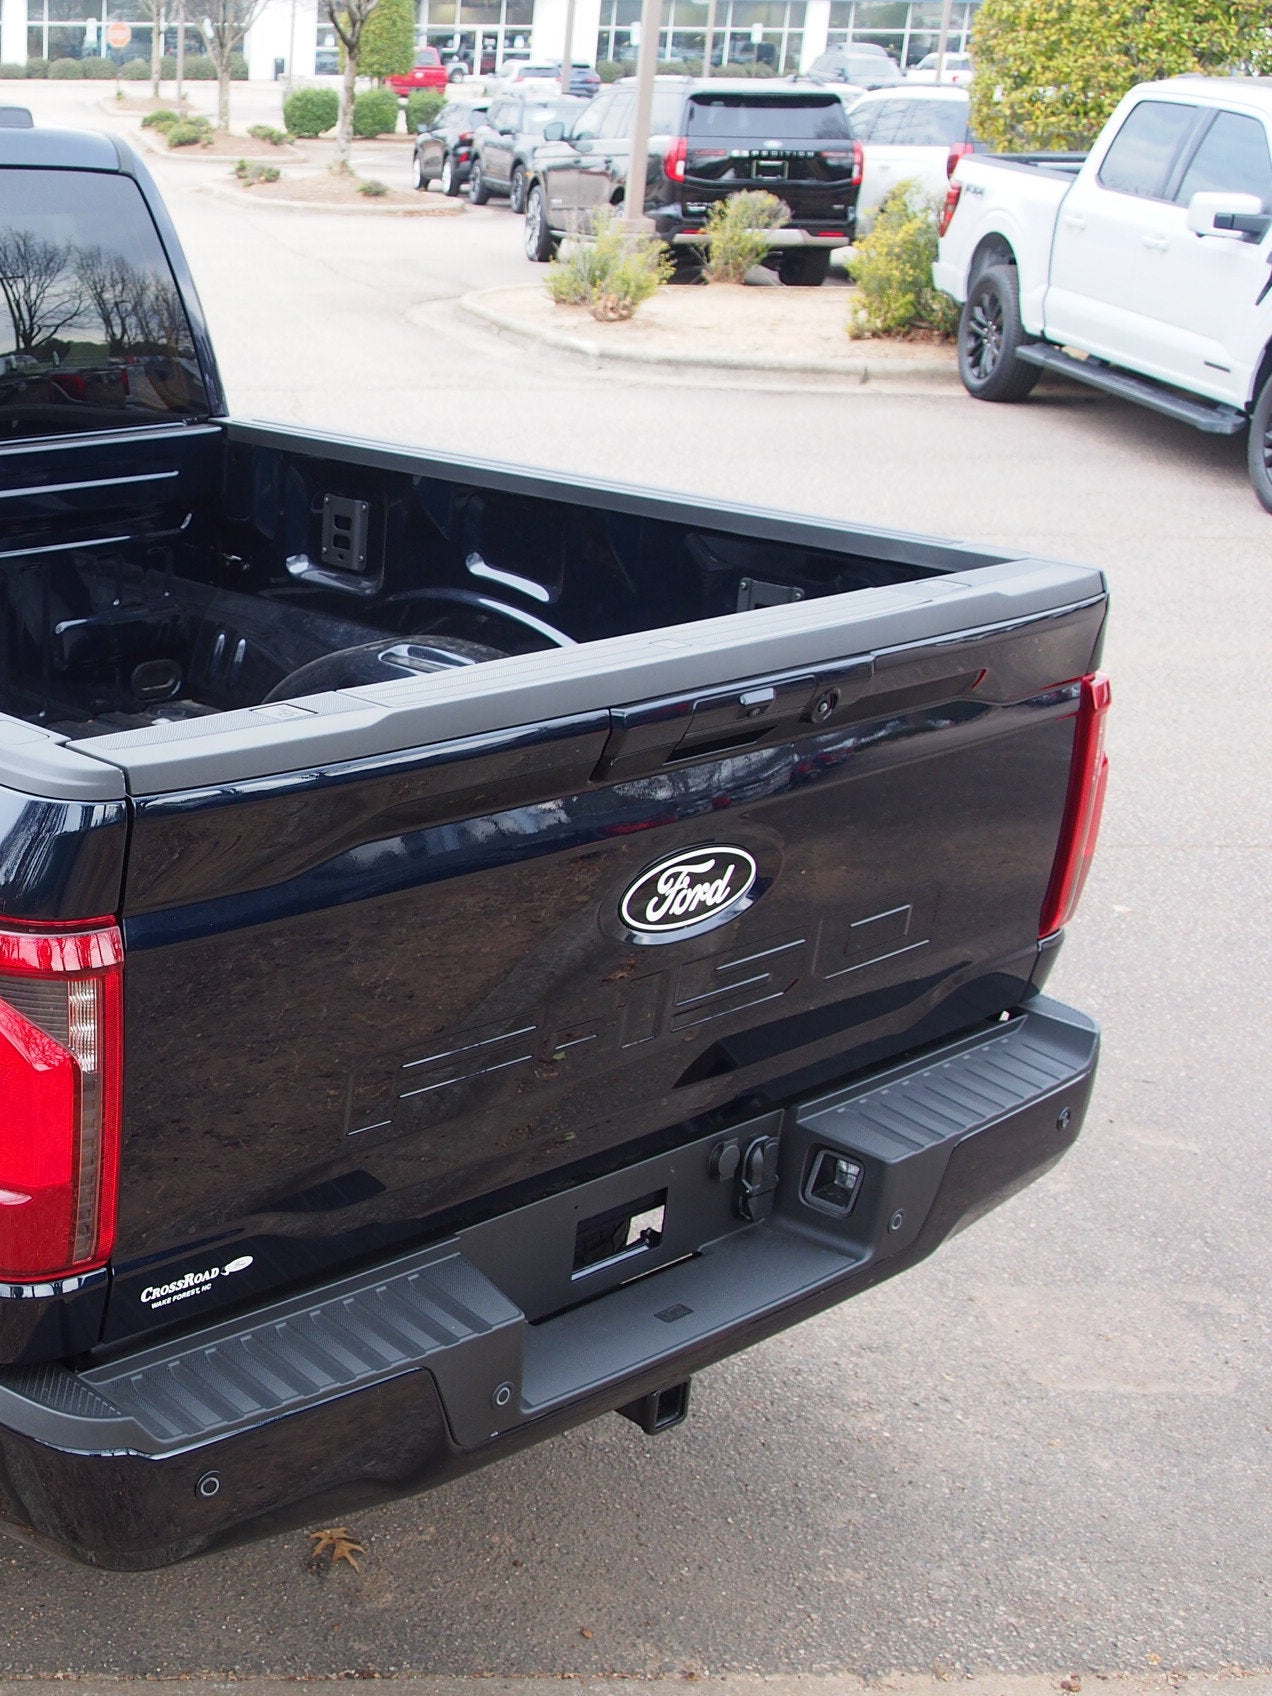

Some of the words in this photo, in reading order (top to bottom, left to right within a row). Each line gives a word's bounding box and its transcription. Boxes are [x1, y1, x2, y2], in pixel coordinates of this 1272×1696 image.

[645, 858, 735, 922] Ford
[346, 884, 939, 1137] F-150
[151, 1297, 172, 1310] WAKE
[201, 1283, 213, 1293] NC
